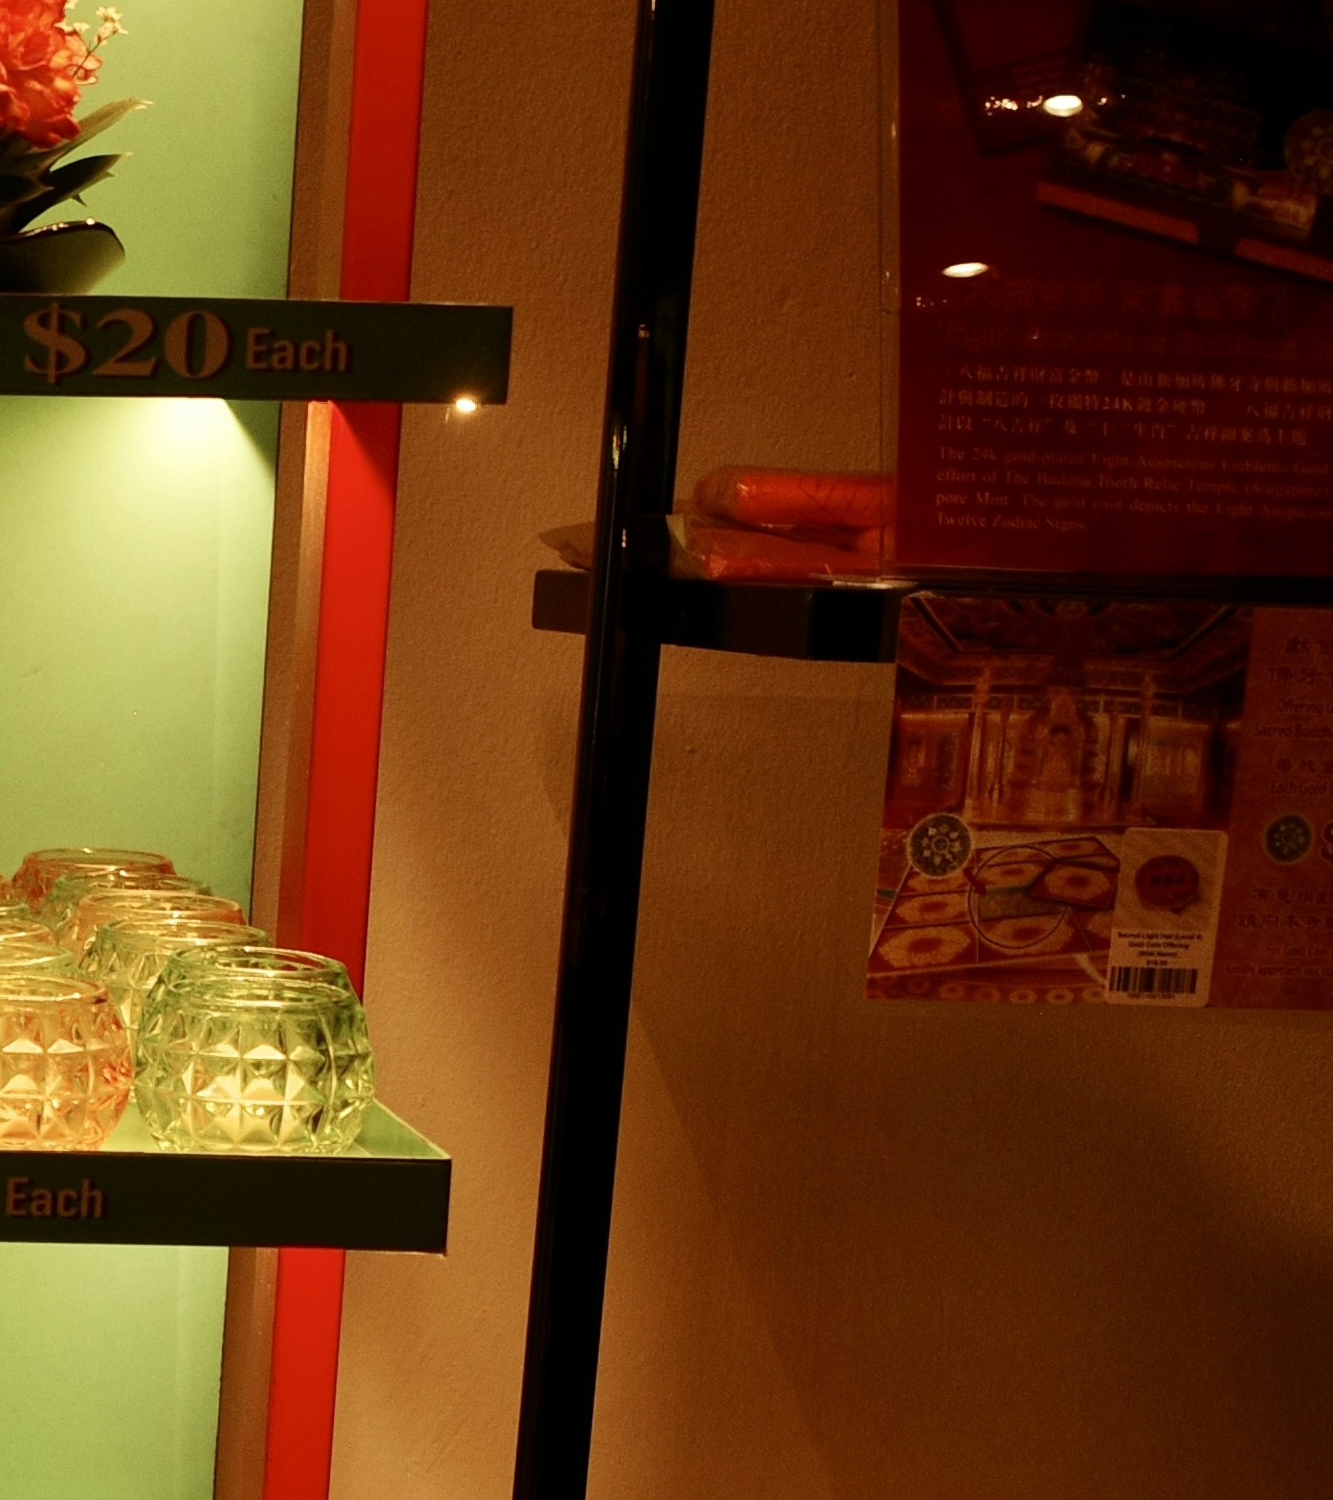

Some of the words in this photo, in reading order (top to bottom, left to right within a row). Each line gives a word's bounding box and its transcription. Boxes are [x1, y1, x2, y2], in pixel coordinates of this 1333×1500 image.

[23, 303, 235, 385] $20
[245, 327, 350, 376] Each
[4, 1176, 108, 1221] Each
